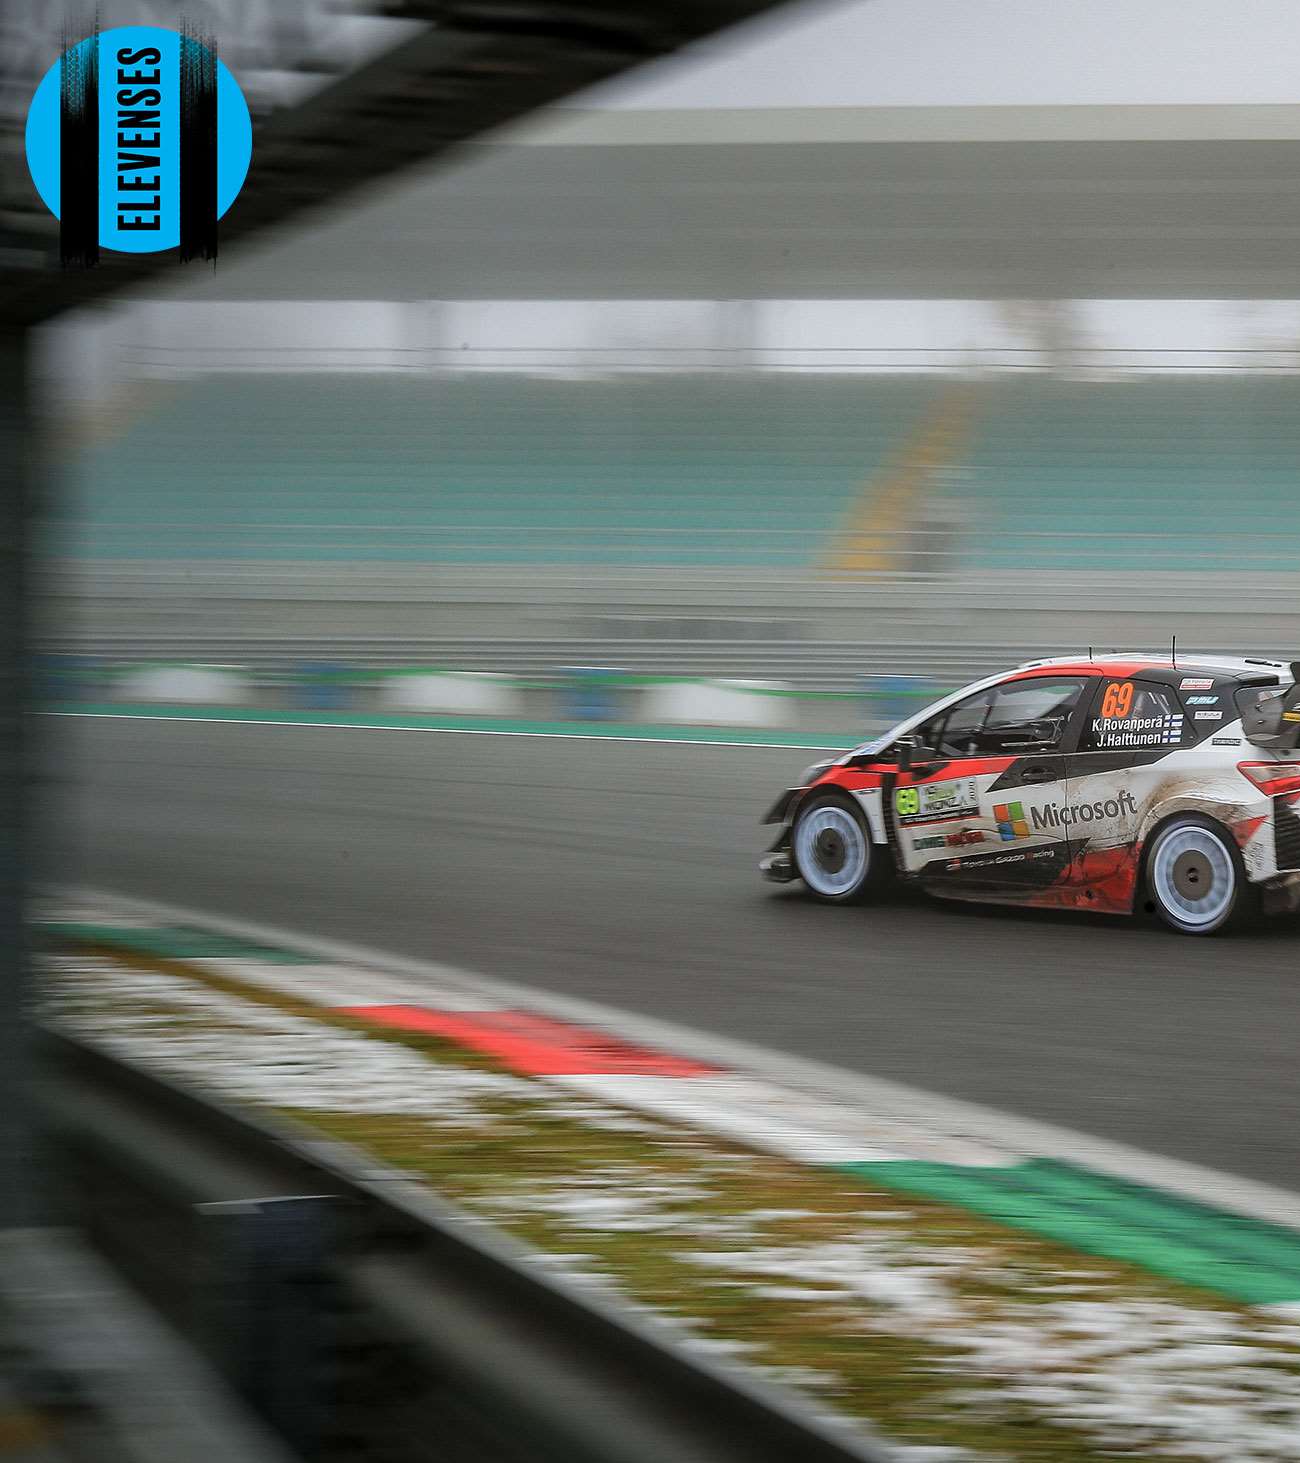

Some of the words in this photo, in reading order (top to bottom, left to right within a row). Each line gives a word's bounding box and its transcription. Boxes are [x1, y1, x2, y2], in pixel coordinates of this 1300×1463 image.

[1102, 682, 1134, 718] 69
[1092, 715, 1163, 732] K.Rovanperä
[1096, 732, 1161, 748] J.Halttunen
[1030, 789, 1138, 830] Microsoft
